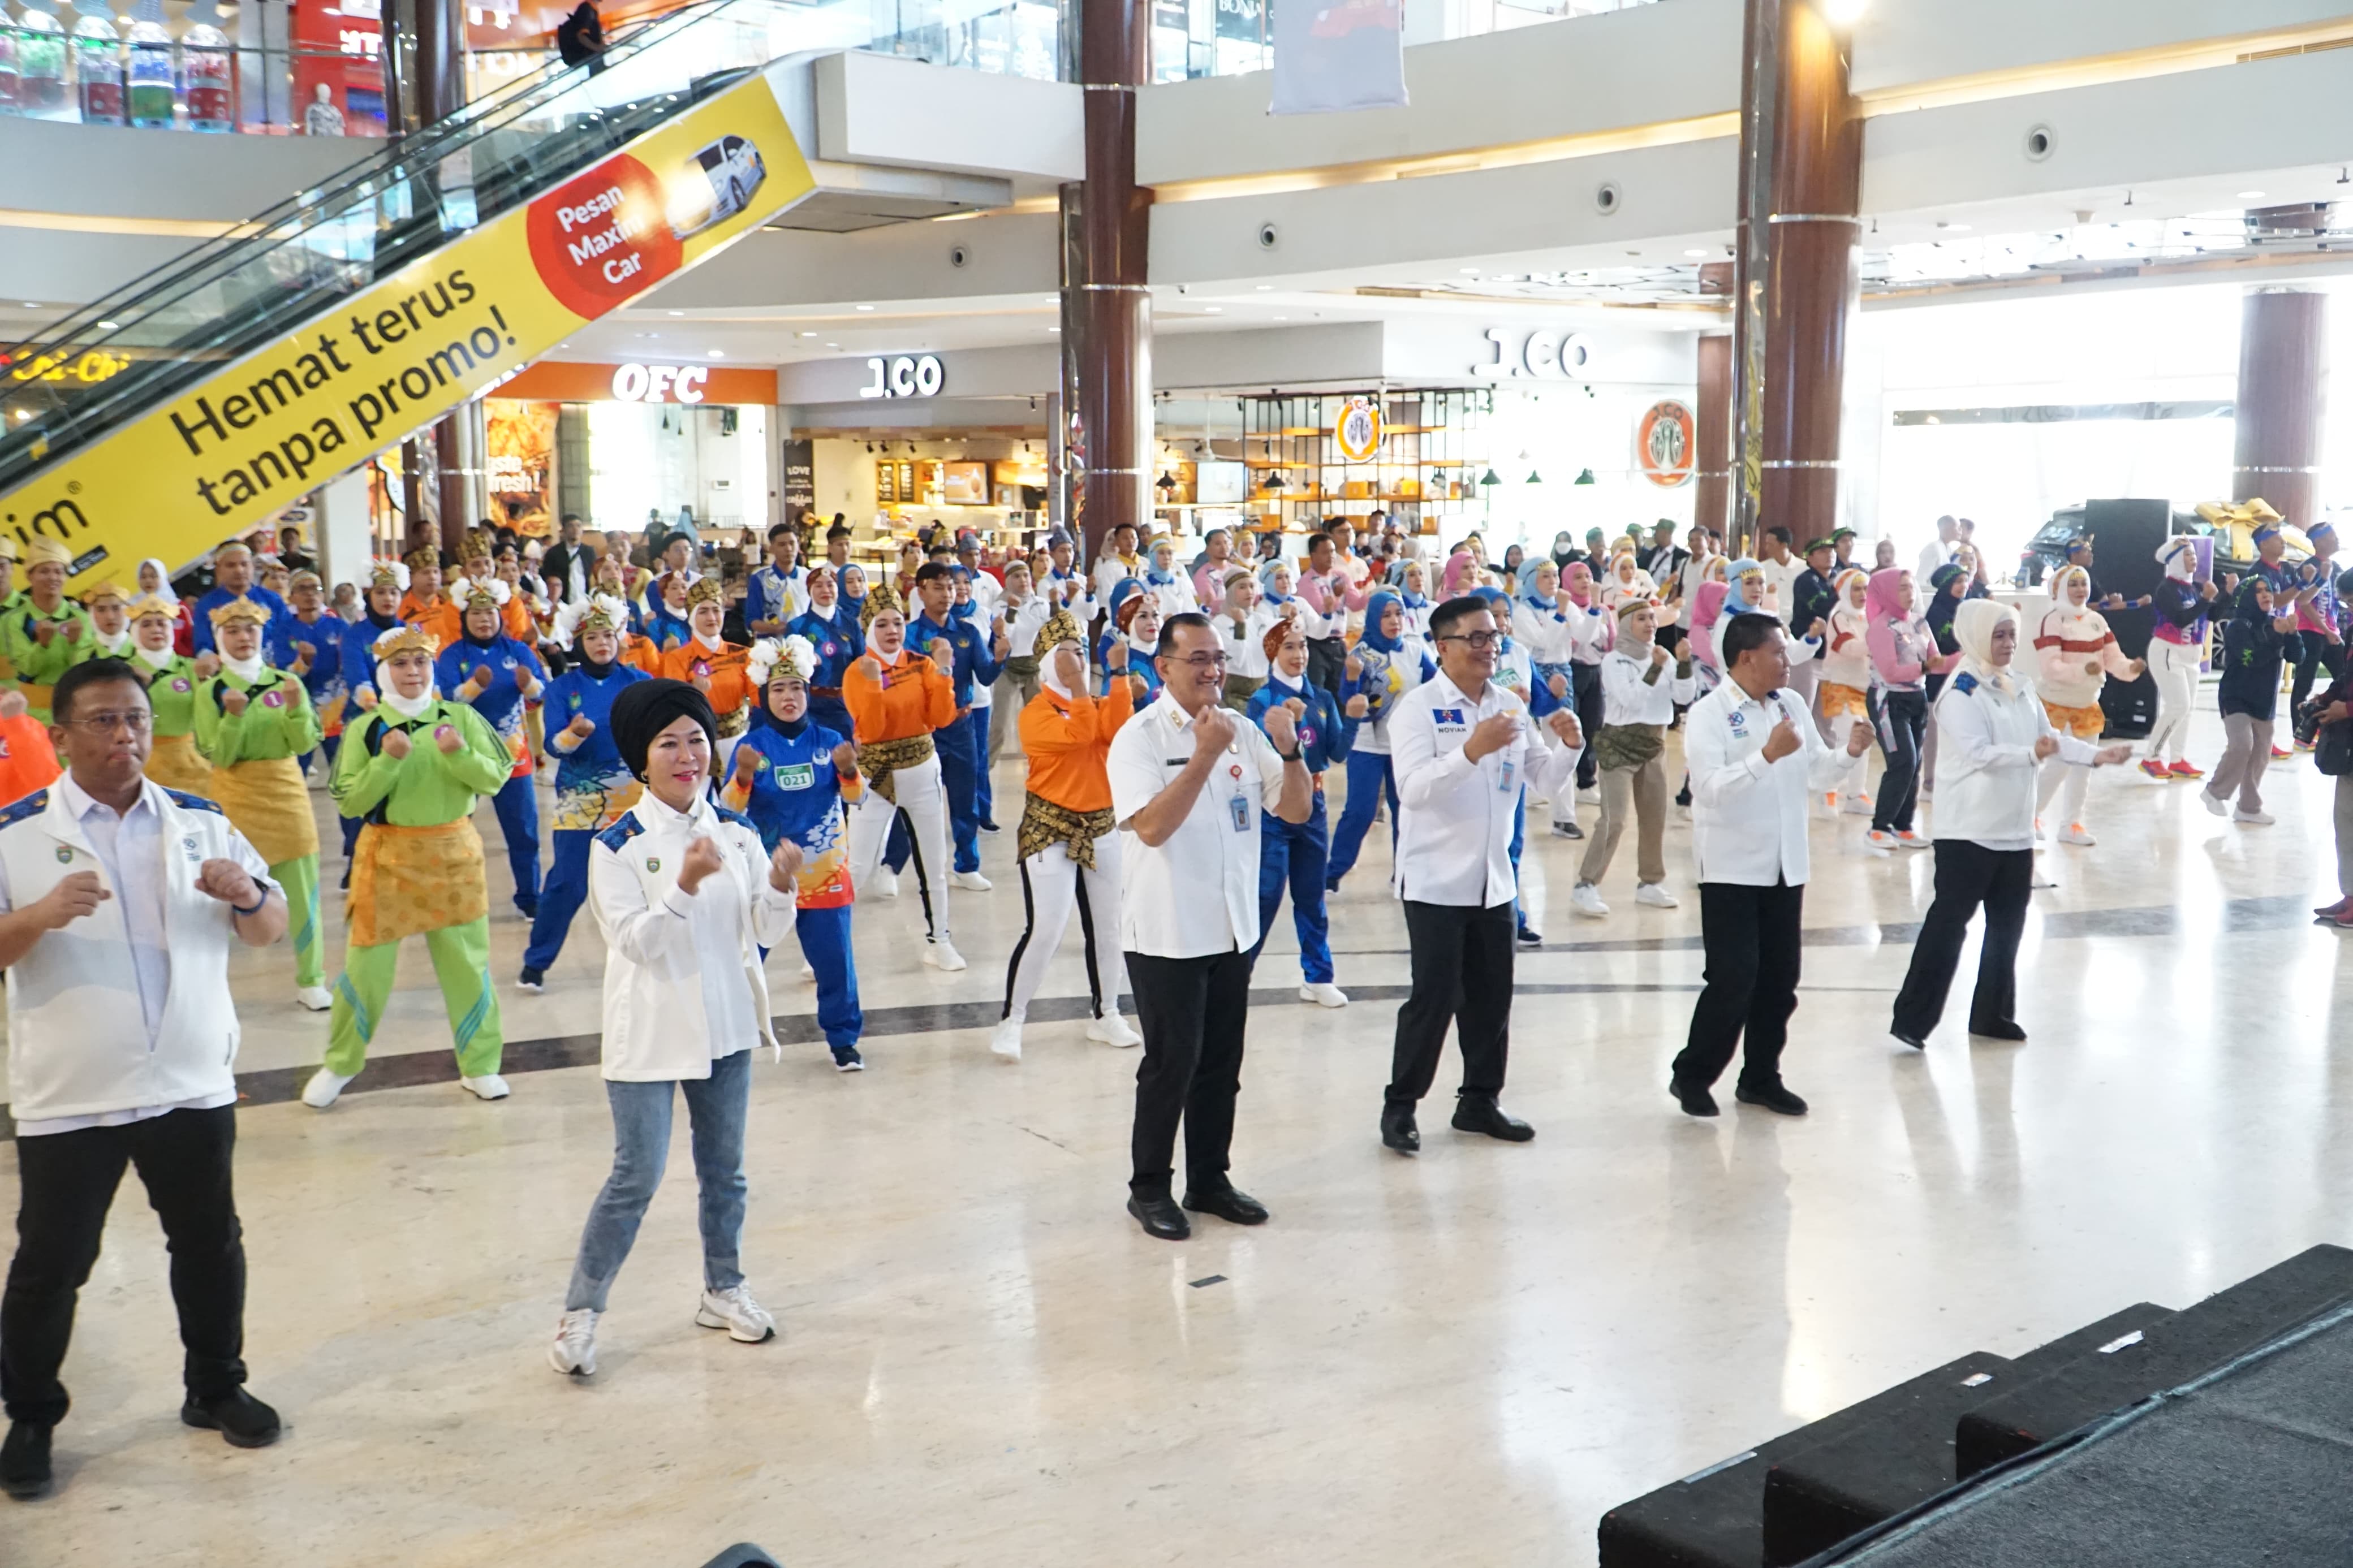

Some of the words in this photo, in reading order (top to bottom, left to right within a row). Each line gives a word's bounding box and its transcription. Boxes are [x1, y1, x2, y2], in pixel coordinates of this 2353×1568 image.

[555, 186, 624, 232] Pesan
[567, 217, 645, 266] Maxim
[603, 252, 642, 283] Car
[170, 334, 352, 456] Hemat
[351, 269, 476, 355] terus
[1471, 328, 1597, 378] J.CO
[613, 363, 708, 404] OFC
[860, 356, 942, 398] J.CO
[196, 417, 347, 515] tanpa
[348, 305, 516, 440] promo!
[786, 466, 810, 475] LOVE
[826, 643, 834, 654] 6
[176, 679, 187, 691] 5
[698, 664, 708, 675] 4
[268, 692, 281, 706] 1
[1303, 729, 1312, 745] 2
[783, 775, 807, 785] 021
